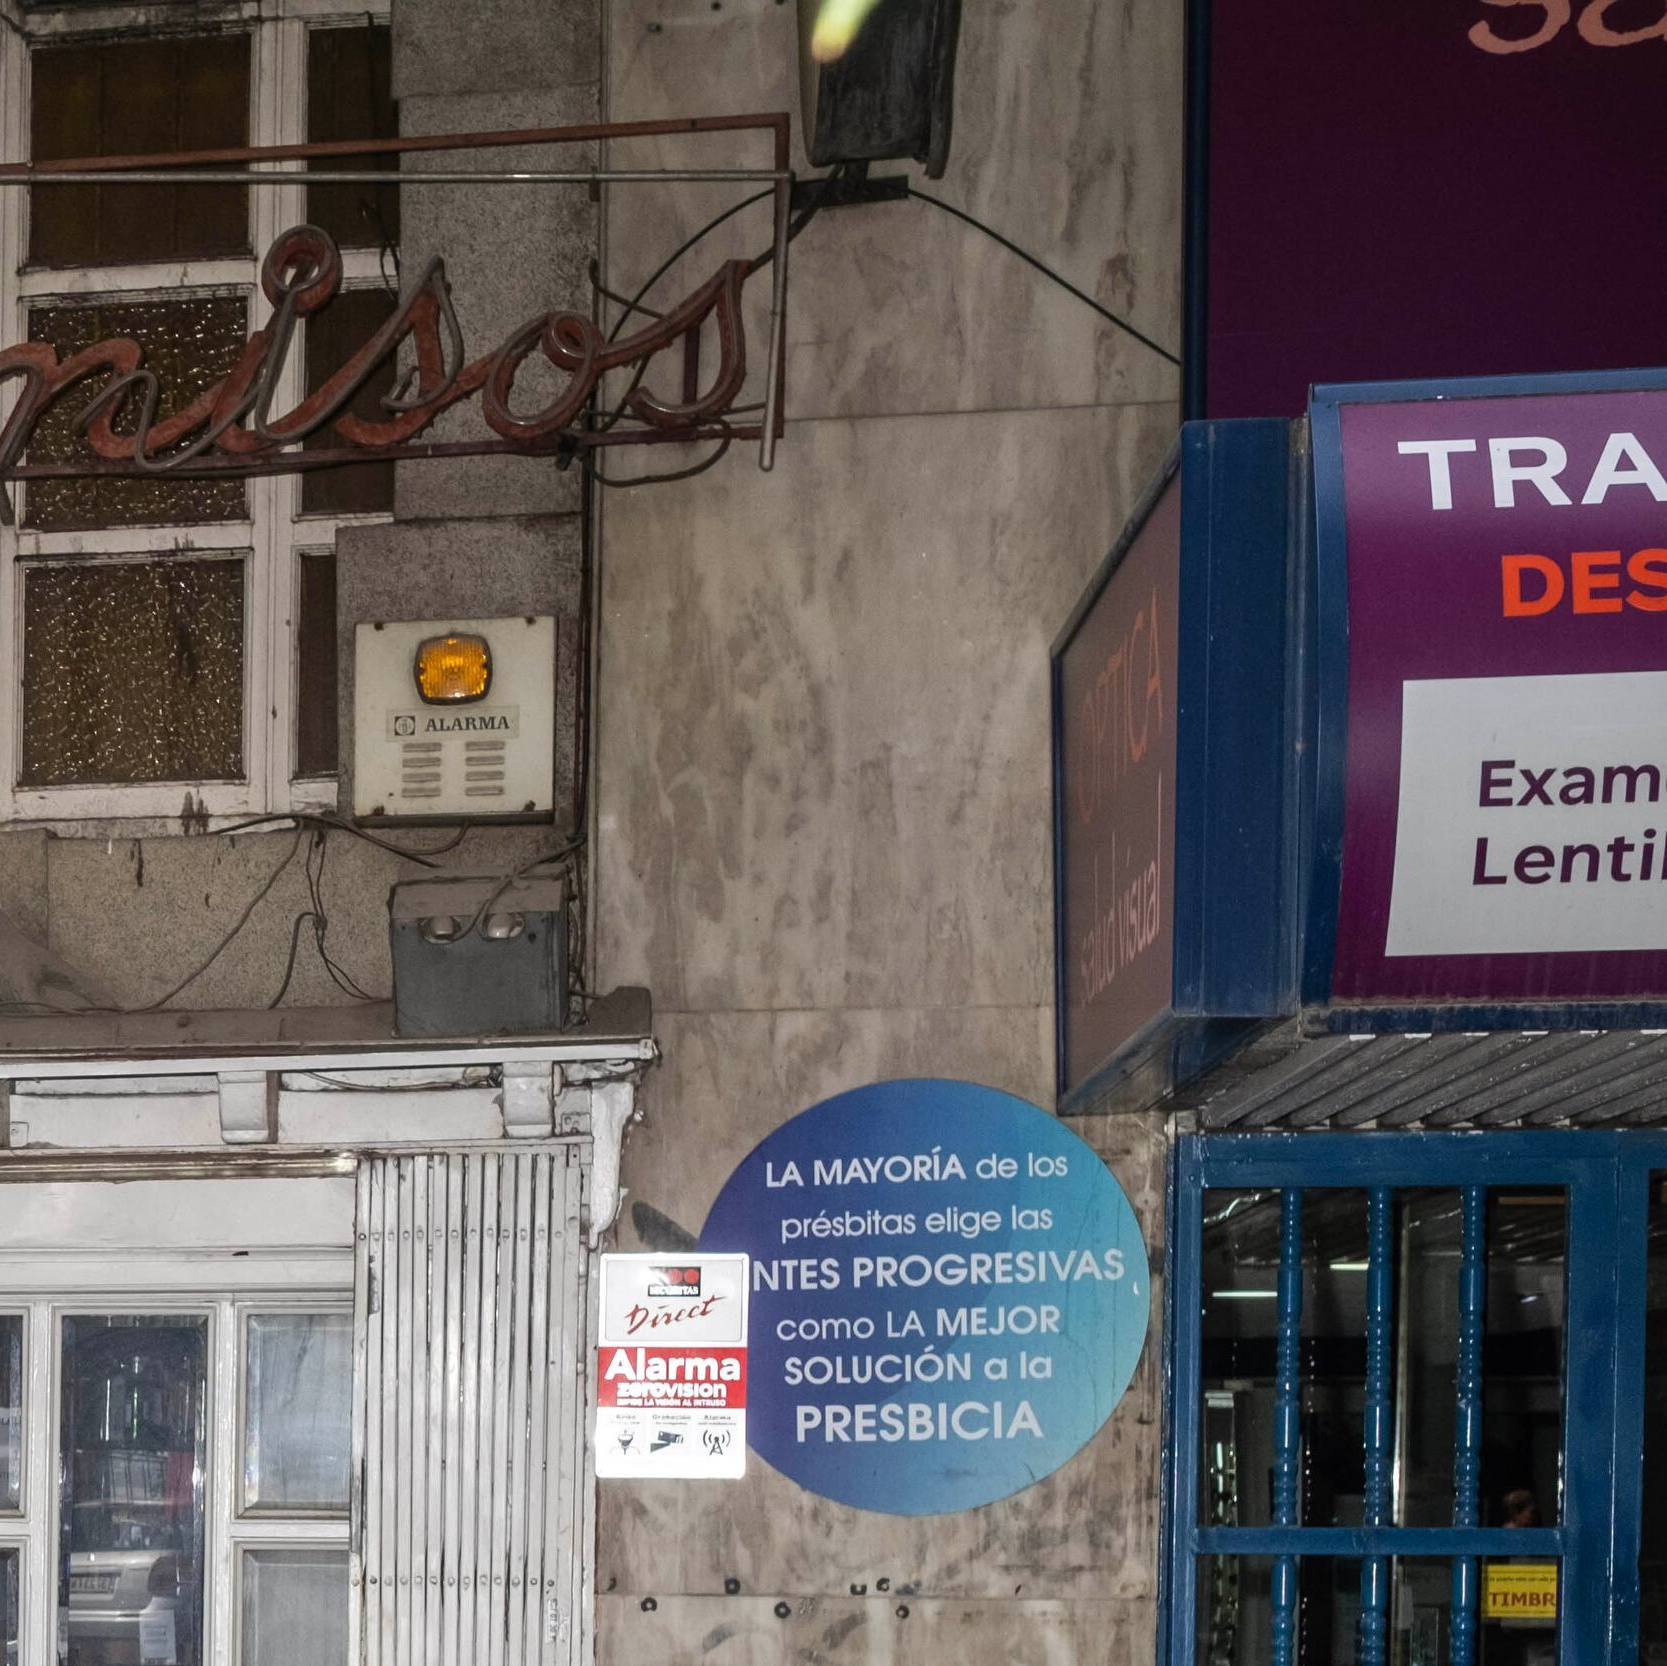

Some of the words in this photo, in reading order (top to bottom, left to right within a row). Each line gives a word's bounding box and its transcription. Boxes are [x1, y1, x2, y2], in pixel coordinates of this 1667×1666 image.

[1397, 431, 1667, 511] TRA
[425, 715, 510, 732] ALARMA
[1478, 757, 1667, 808] Exam
[1080, 830, 1117, 1007] salud
[766, 1160, 803, 1188] LA
[814, 1146, 966, 1185] MAYORÍA
[975, 1155, 1018, 1179] de
[1028, 1152, 1068, 1177] los
[780, 1209, 916, 1243] présbitas
[925, 1205, 1001, 1238] elige
[1011, 1205, 1053, 1231] las
[753, 1258, 840, 1292] NTES
[853, 1247, 1124, 1289] PROGRESIVAS
[624, 1295, 727, 1335] Direct
[776, 1317, 875, 1341] como
[886, 1312, 925, 1338] LA
[936, 1306, 1061, 1336] MEJOR
[604, 1348, 740, 1381] Alarma
[784, 1346, 971, 1385] SOLUCIÓN
[984, 1358, 1007, 1379] a
[1019, 1351, 1053, 1379] la
[616, 1382, 727, 1398] zerovision
[796, 1401, 1044, 1443] PRESBICIA
